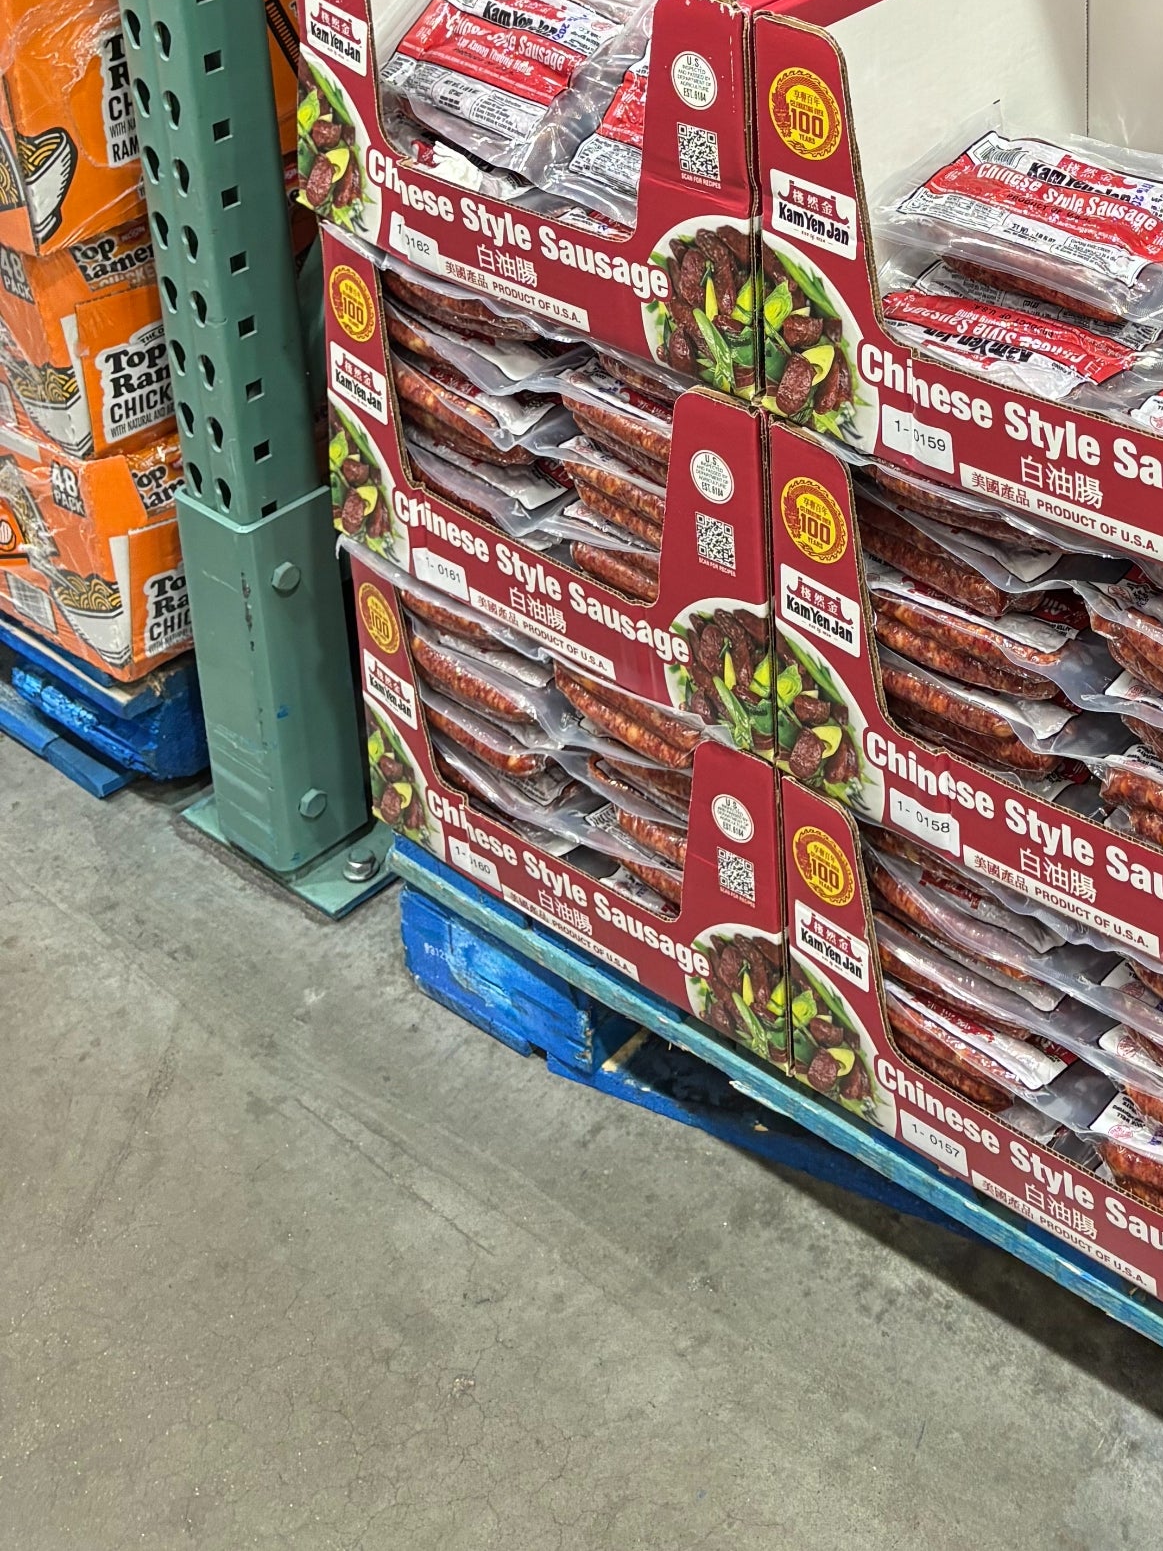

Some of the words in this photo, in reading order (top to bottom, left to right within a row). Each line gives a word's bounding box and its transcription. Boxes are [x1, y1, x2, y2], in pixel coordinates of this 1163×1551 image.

[310, 21, 329, 44] Kam
[329, 30, 344, 55] Yen
[344, 40, 362, 63] Jan
[778, 201, 804, 228] Kam
[803, 211, 826, 238] Yen
[826, 220, 850, 247] Jan
[0, 250, 25, 283] 48
[460, 196, 533, 250] Style
[538, 225, 670, 299] Sausage
[4, 275, 33, 301] PACK
[105, 343, 167, 375] Top
[110, 382, 173, 424] CHICK
[862, 344, 993, 429] Chinese
[1004, 401, 1101, 467] Style
[111, 423, 127, 438] WITH
[127, 412, 153, 431] NATURAL
[912, 430, 947, 453] 0159
[53, 465, 78, 498] 48
[55, 490, 84, 514] PACK
[1020, 455, 1105, 511] 白油腸
[394, 489, 491, 563] Chinese
[496, 542, 562, 601] Style
[568, 577, 690, 663] Sausage
[786, 594, 812, 620] Kam
[810, 605, 831, 633] Yen
[831, 619, 853, 645] Jan
[866, 731, 996, 819] Chinese
[1004, 797, 1096, 868] Style
[915, 812, 951, 834] 0158
[522, 850, 588, 908] Style
[593, 891, 710, 978] Sausage
[800, 927, 825, 952] Kam
[823, 941, 843, 966] Yen
[842, 954, 863, 981] Jan
[876, 1057, 1001, 1155] Chinese
[1008, 1140, 1096, 1211] Style
[928, 1133, 961, 1160] 0157
